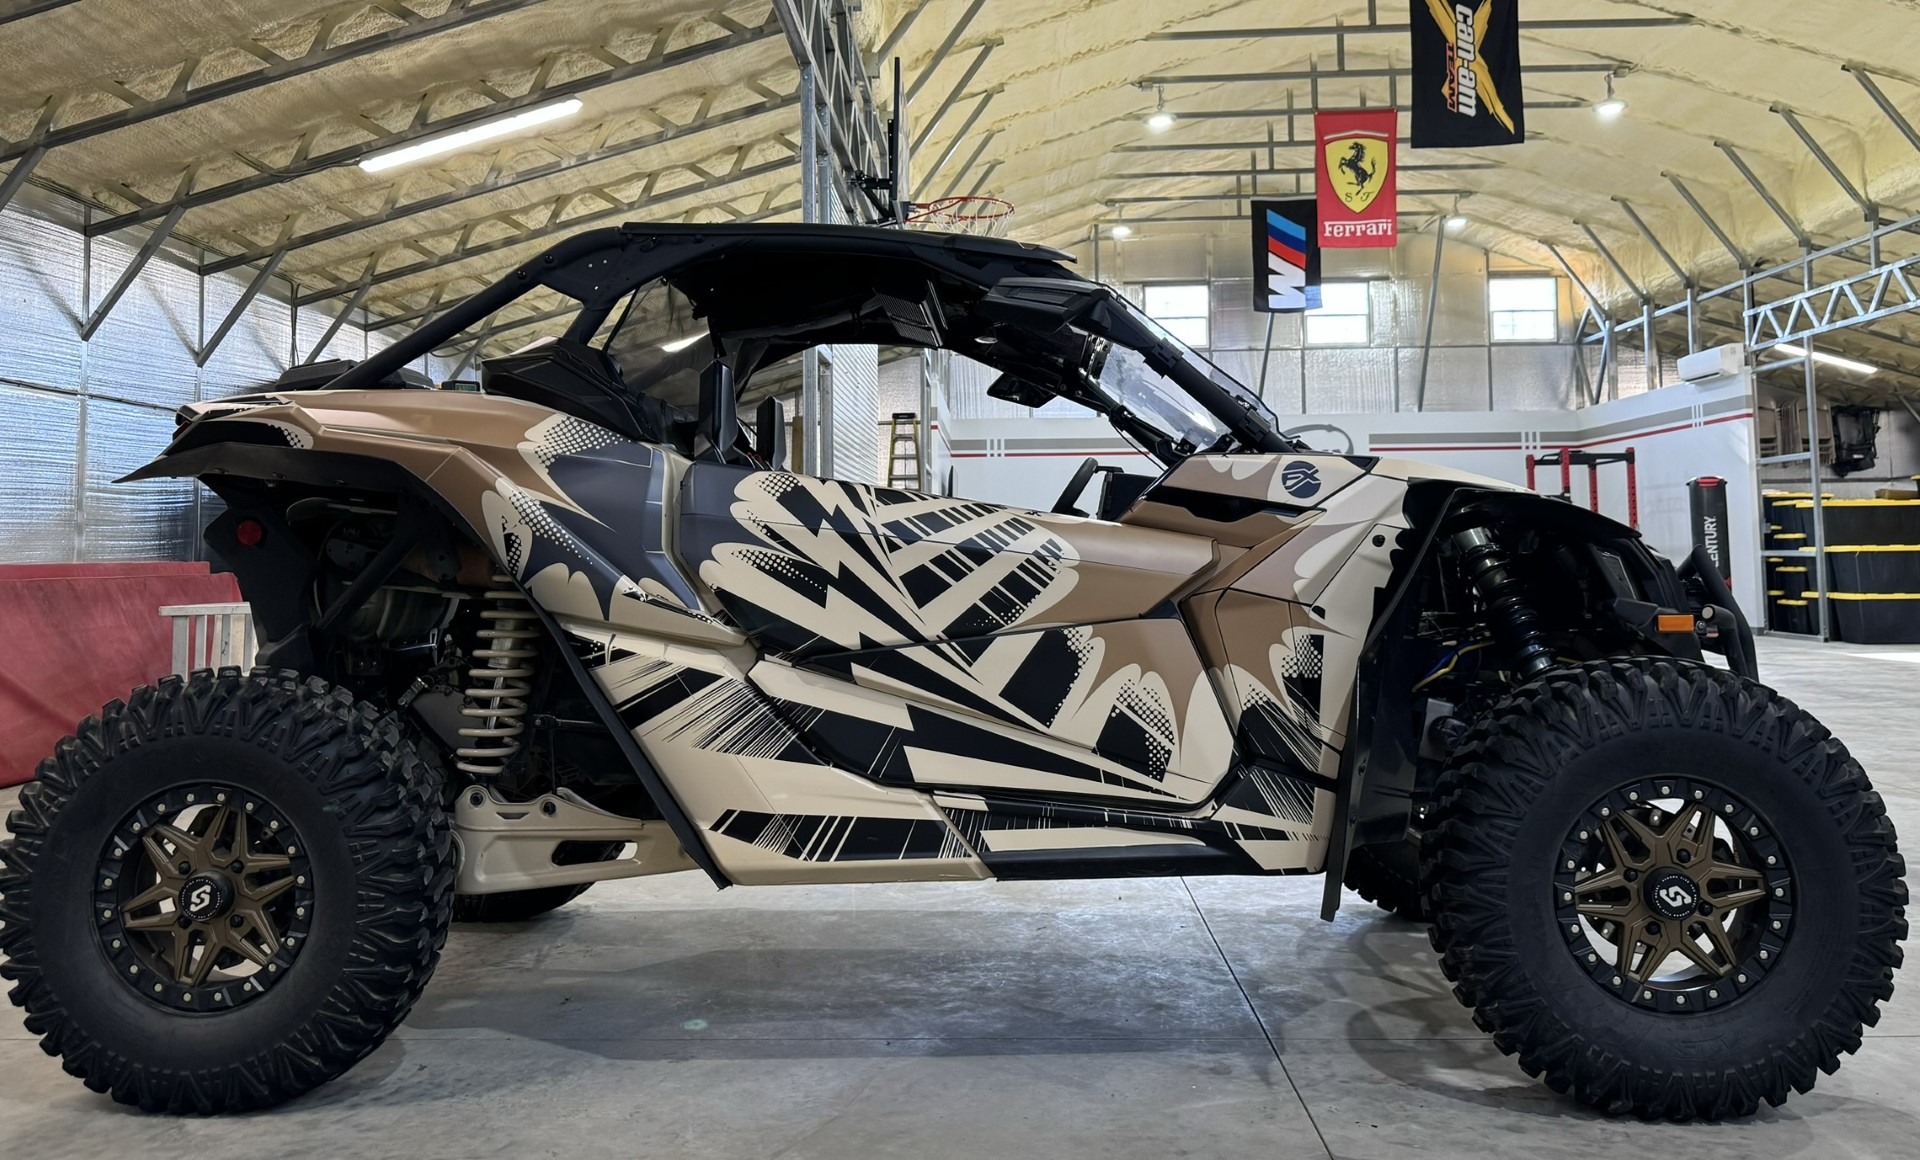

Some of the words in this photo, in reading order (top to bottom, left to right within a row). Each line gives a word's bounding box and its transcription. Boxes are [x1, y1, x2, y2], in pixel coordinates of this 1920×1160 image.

[1455, 3, 1476, 117] can-am
[1345, 192, 1353, 203] S
[1323, 219, 1392, 237] Ferrari
[1268, 251, 1306, 308] M
